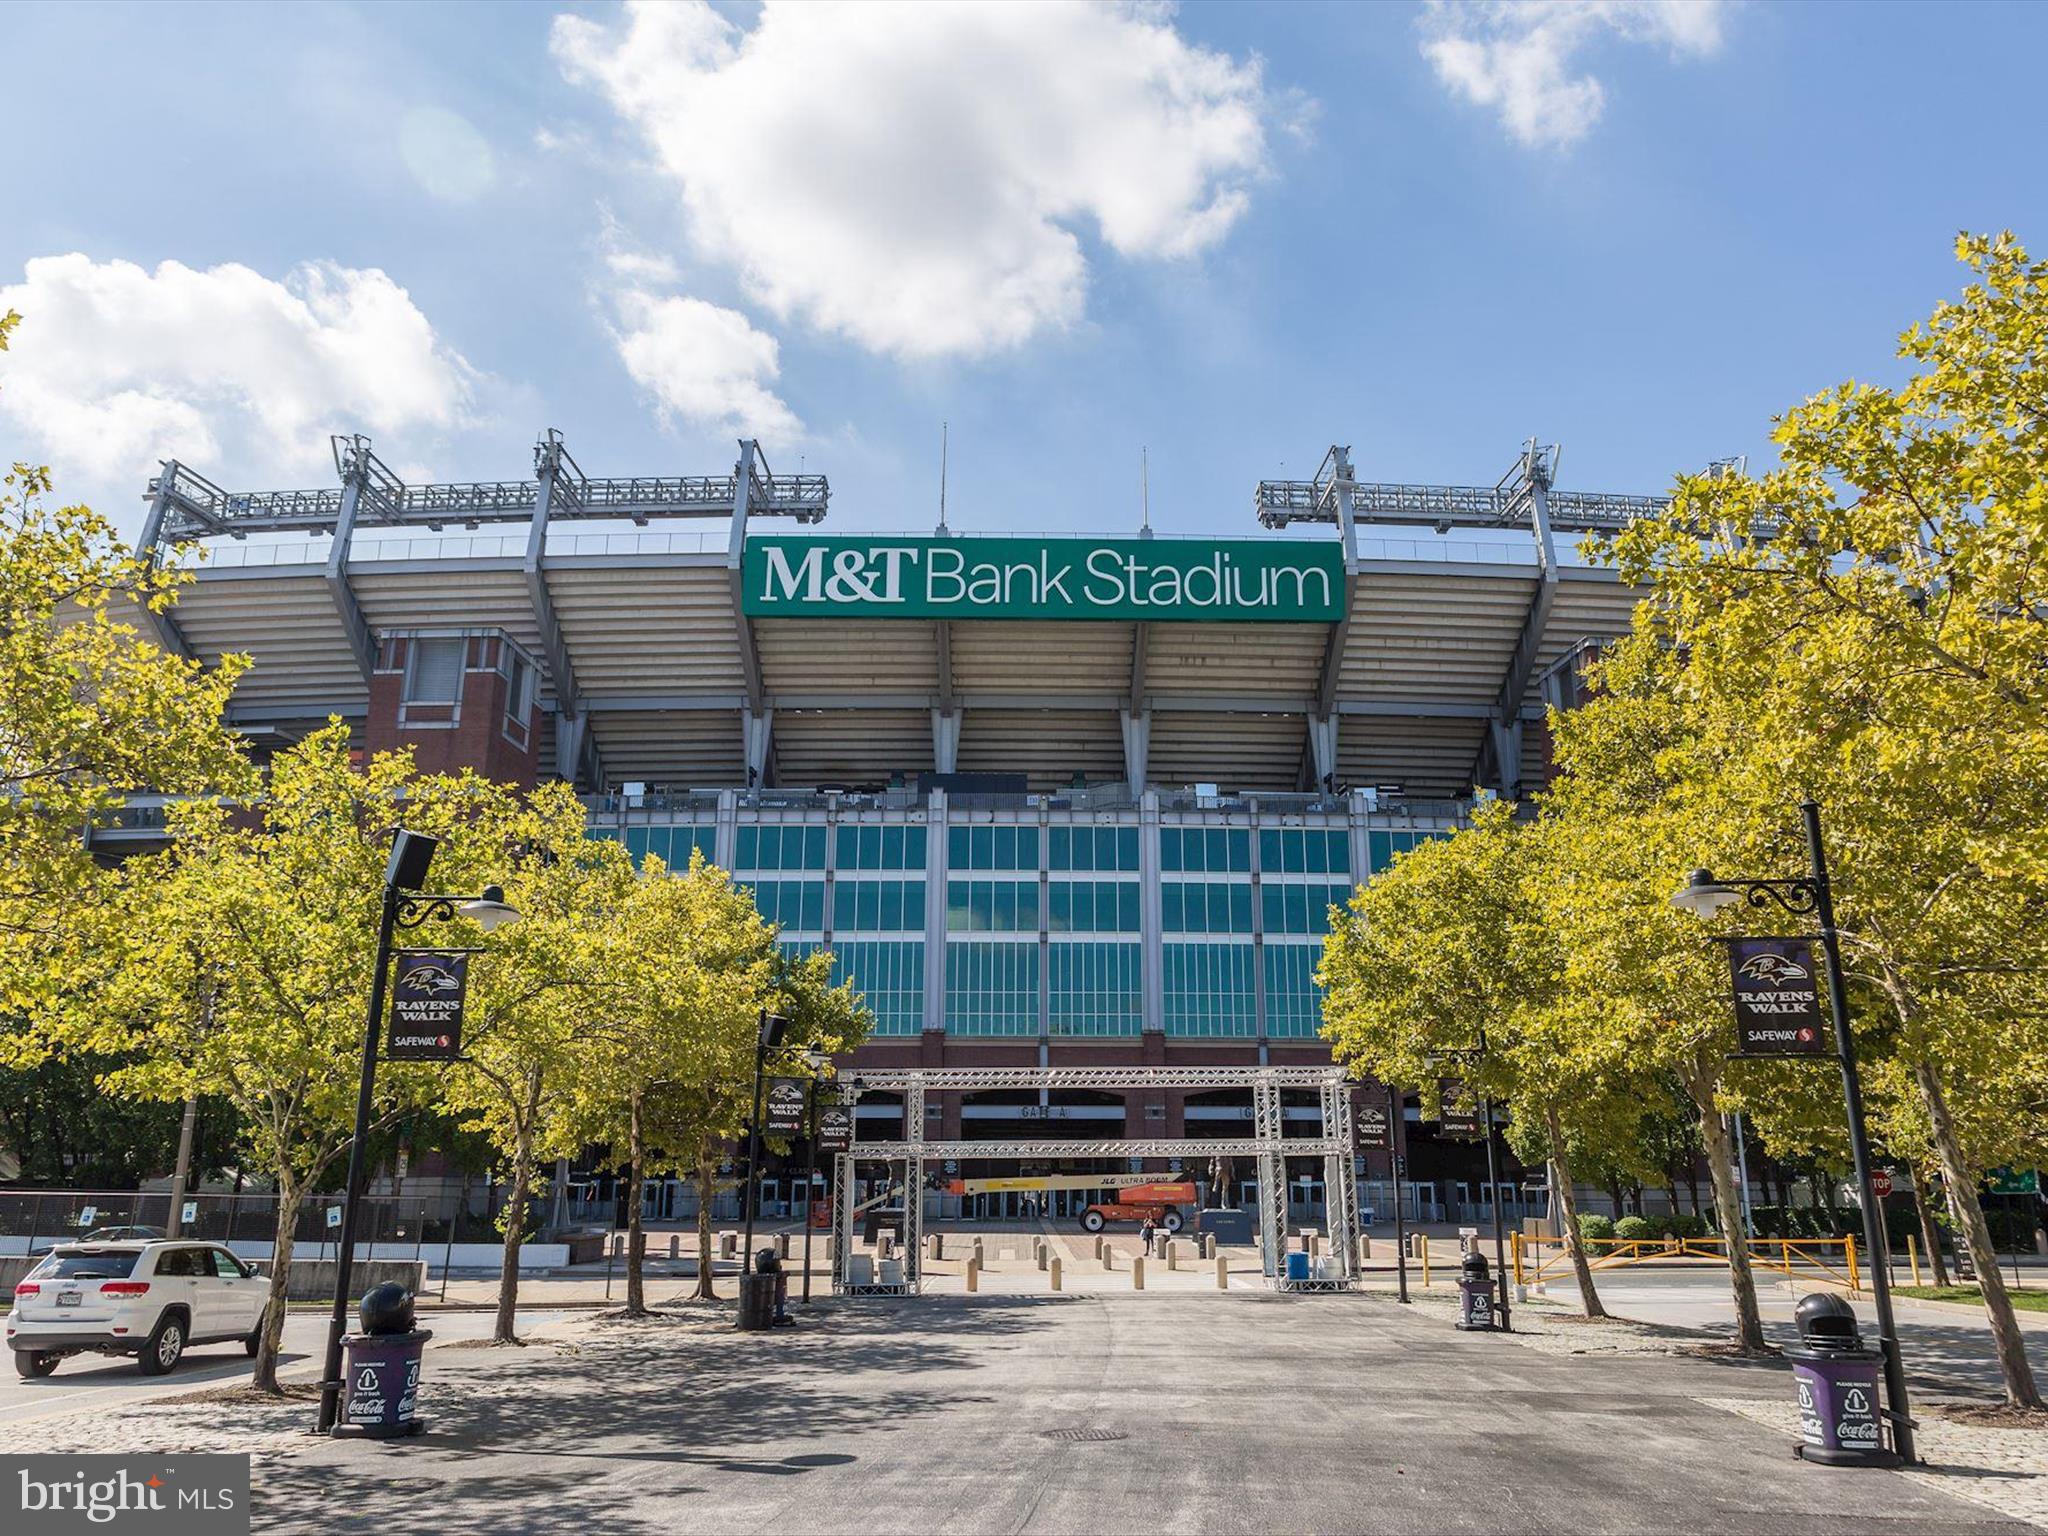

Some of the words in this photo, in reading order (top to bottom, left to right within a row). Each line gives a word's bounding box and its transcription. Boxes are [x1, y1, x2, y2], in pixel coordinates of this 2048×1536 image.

[759, 546, 918, 602] M&T
[926, 548, 1074, 604] Bank
[1083, 548, 1330, 606] Stadium
[1738, 991, 1814, 1002] RAVENS
[396, 1001, 460, 1010] RAVENS
[1747, 1003, 1809, 1013] WALK
[401, 1012, 451, 1020] WALK
[1748, 1029, 1797, 1041] SAFEWAY
[394, 1036, 437, 1046] SAFEWAY
